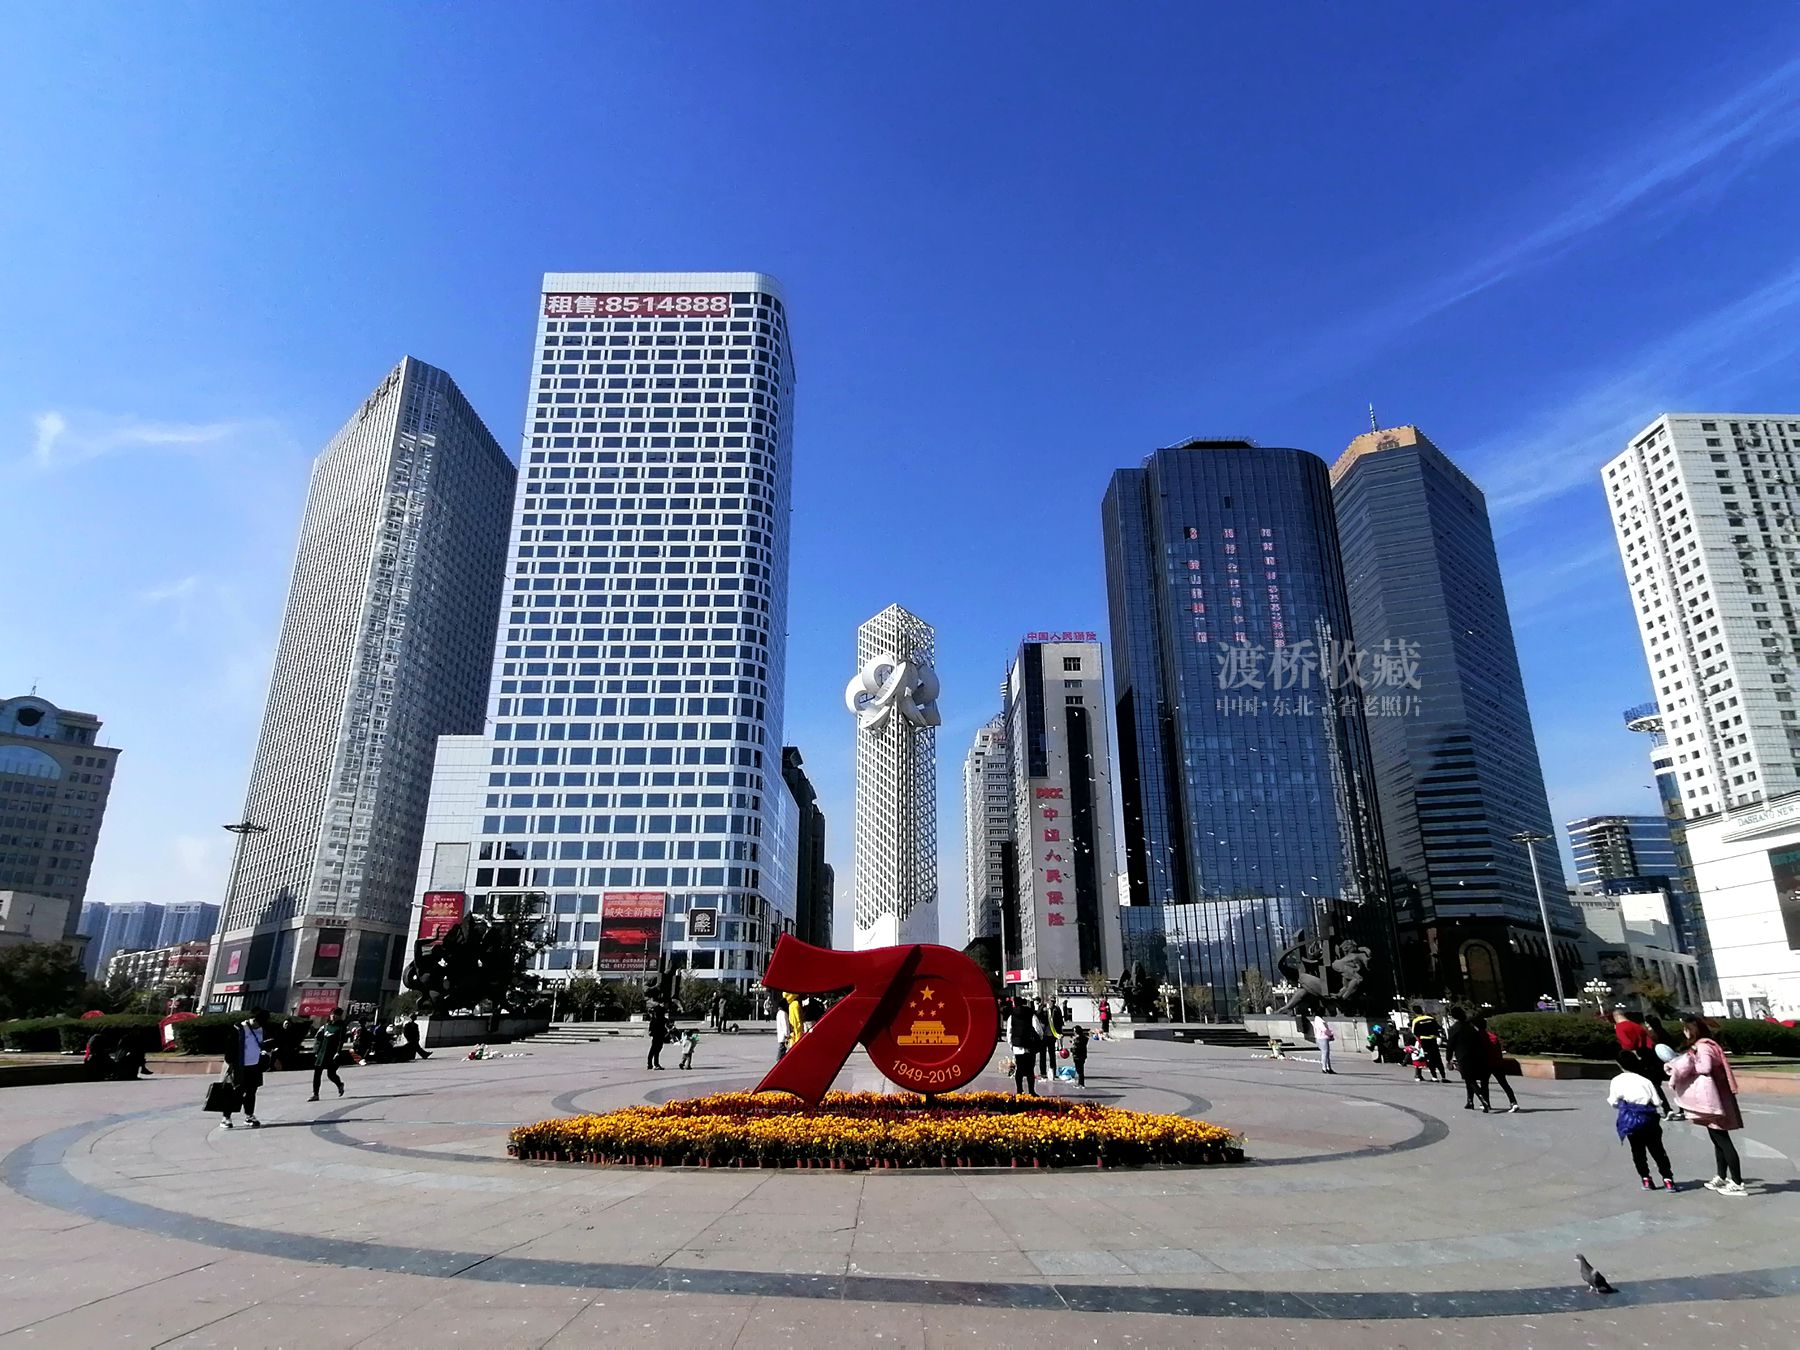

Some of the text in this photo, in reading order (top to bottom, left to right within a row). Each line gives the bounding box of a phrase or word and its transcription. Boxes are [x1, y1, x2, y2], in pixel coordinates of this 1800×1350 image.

[547, 295, 728, 314] 租售:8514888
[1026, 631, 1097, 641] 中国人民保险
[1043, 807, 1066, 927] 中国人民保险
[892, 1060, 962, 1084] 1949-2019
